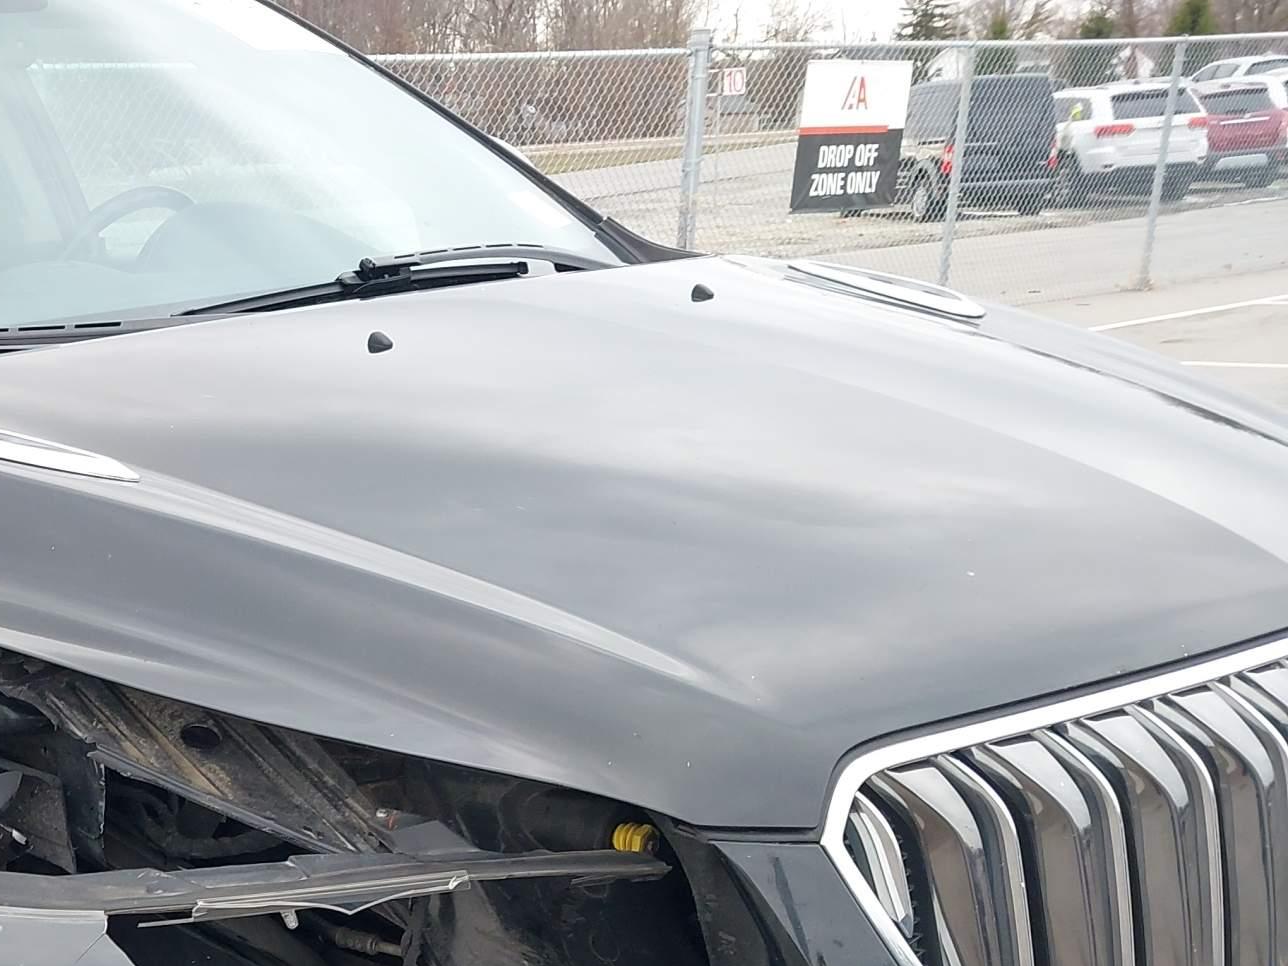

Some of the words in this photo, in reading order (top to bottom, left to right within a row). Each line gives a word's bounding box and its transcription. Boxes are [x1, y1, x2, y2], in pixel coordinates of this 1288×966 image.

[726, 70, 745, 93] 10
[817, 144, 854, 169] DROP
[855, 143, 880, 167] OFF
[809, 172, 845, 197] ZONE
[846, 170, 881, 194] ONLY
